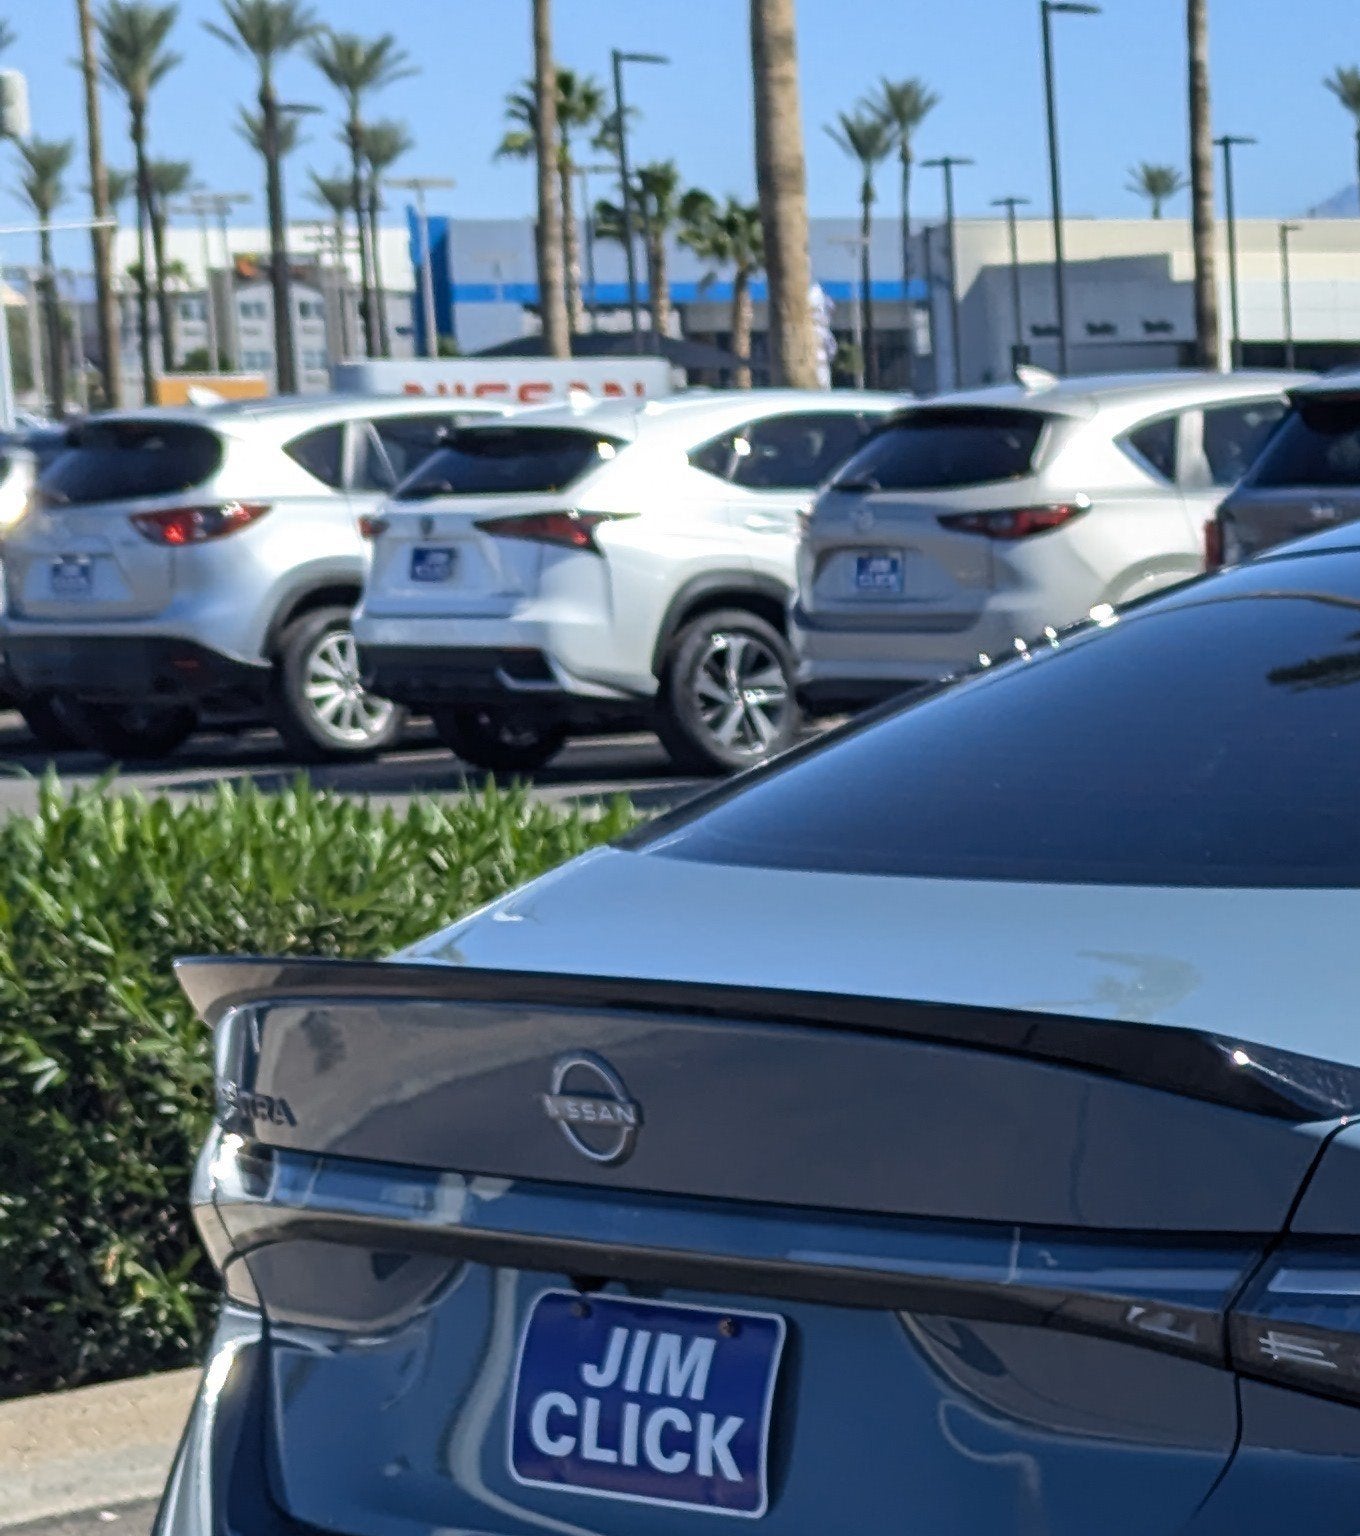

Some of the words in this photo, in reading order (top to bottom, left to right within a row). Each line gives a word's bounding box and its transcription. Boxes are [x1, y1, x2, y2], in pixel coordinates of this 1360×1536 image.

[543, 1094, 636, 1124] NSSAN
[582, 1327, 716, 1400] JIM
[531, 1391, 744, 1482] CLICK
